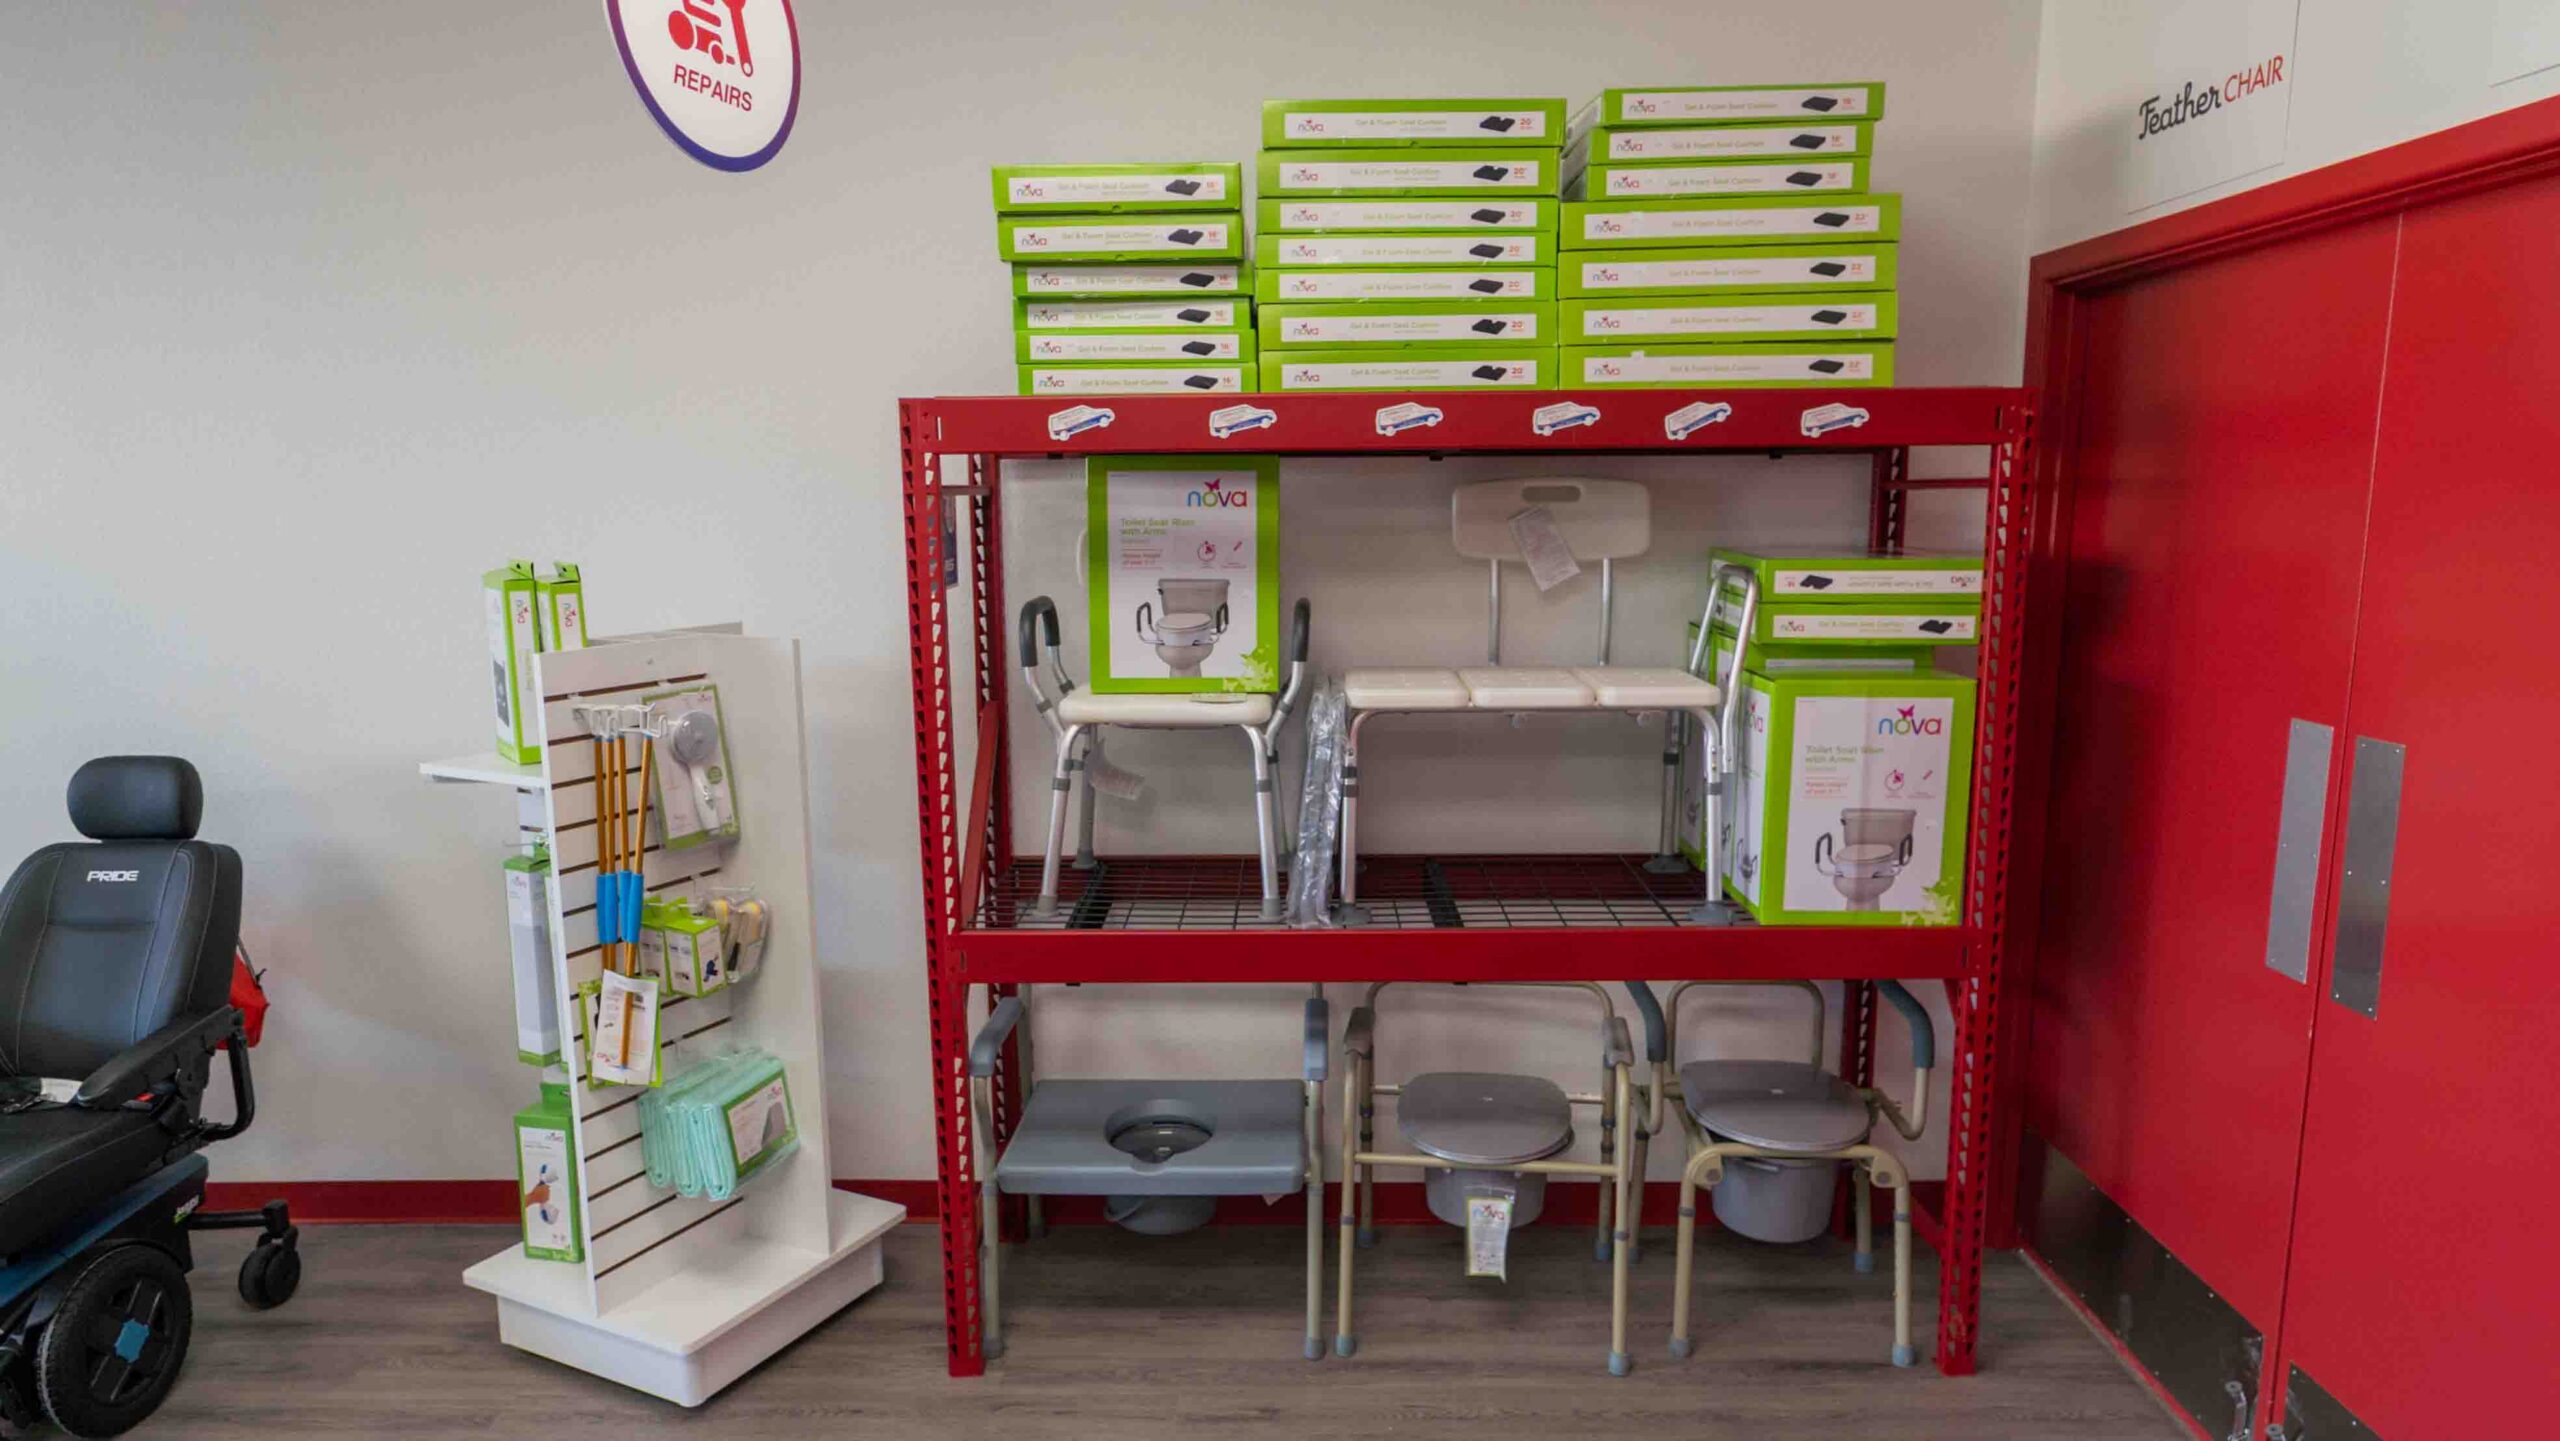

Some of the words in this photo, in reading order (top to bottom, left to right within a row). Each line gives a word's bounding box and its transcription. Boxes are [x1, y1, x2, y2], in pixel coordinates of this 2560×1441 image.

[674, 64, 752, 112] REPAIRS
[2138, 82, 2222, 140] Feather
[2224, 55, 2284, 103] CHAIR
[1629, 102, 1656, 113] nova
[1298, 122, 1324, 132] nova
[1616, 142, 1643, 152] nova
[1292, 172, 1318, 181] nova
[1613, 178, 1640, 188] nova
[1016, 186, 1044, 196] nova
[1292, 212, 1318, 222] nova
[1594, 222, 1621, 232] nova
[1022, 236, 1048, 246] nova
[1292, 248, 1317, 257] nova
[1034, 276, 1060, 286] nova
[1592, 272, 1619, 282] nova
[1292, 282, 1317, 292] nova
[1034, 311, 1058, 321] nova
[1593, 318, 1620, 328] nova
[1294, 326, 1319, 336] nova
[1036, 344, 1062, 354] nova
[1594, 366, 1621, 376] nova
[1039, 378, 1064, 387] nova
[1294, 373, 1320, 382] nova
[1187, 486, 1248, 508] nova
[1878, 713, 1943, 736] nova
[87, 870, 140, 882] PRIDE
